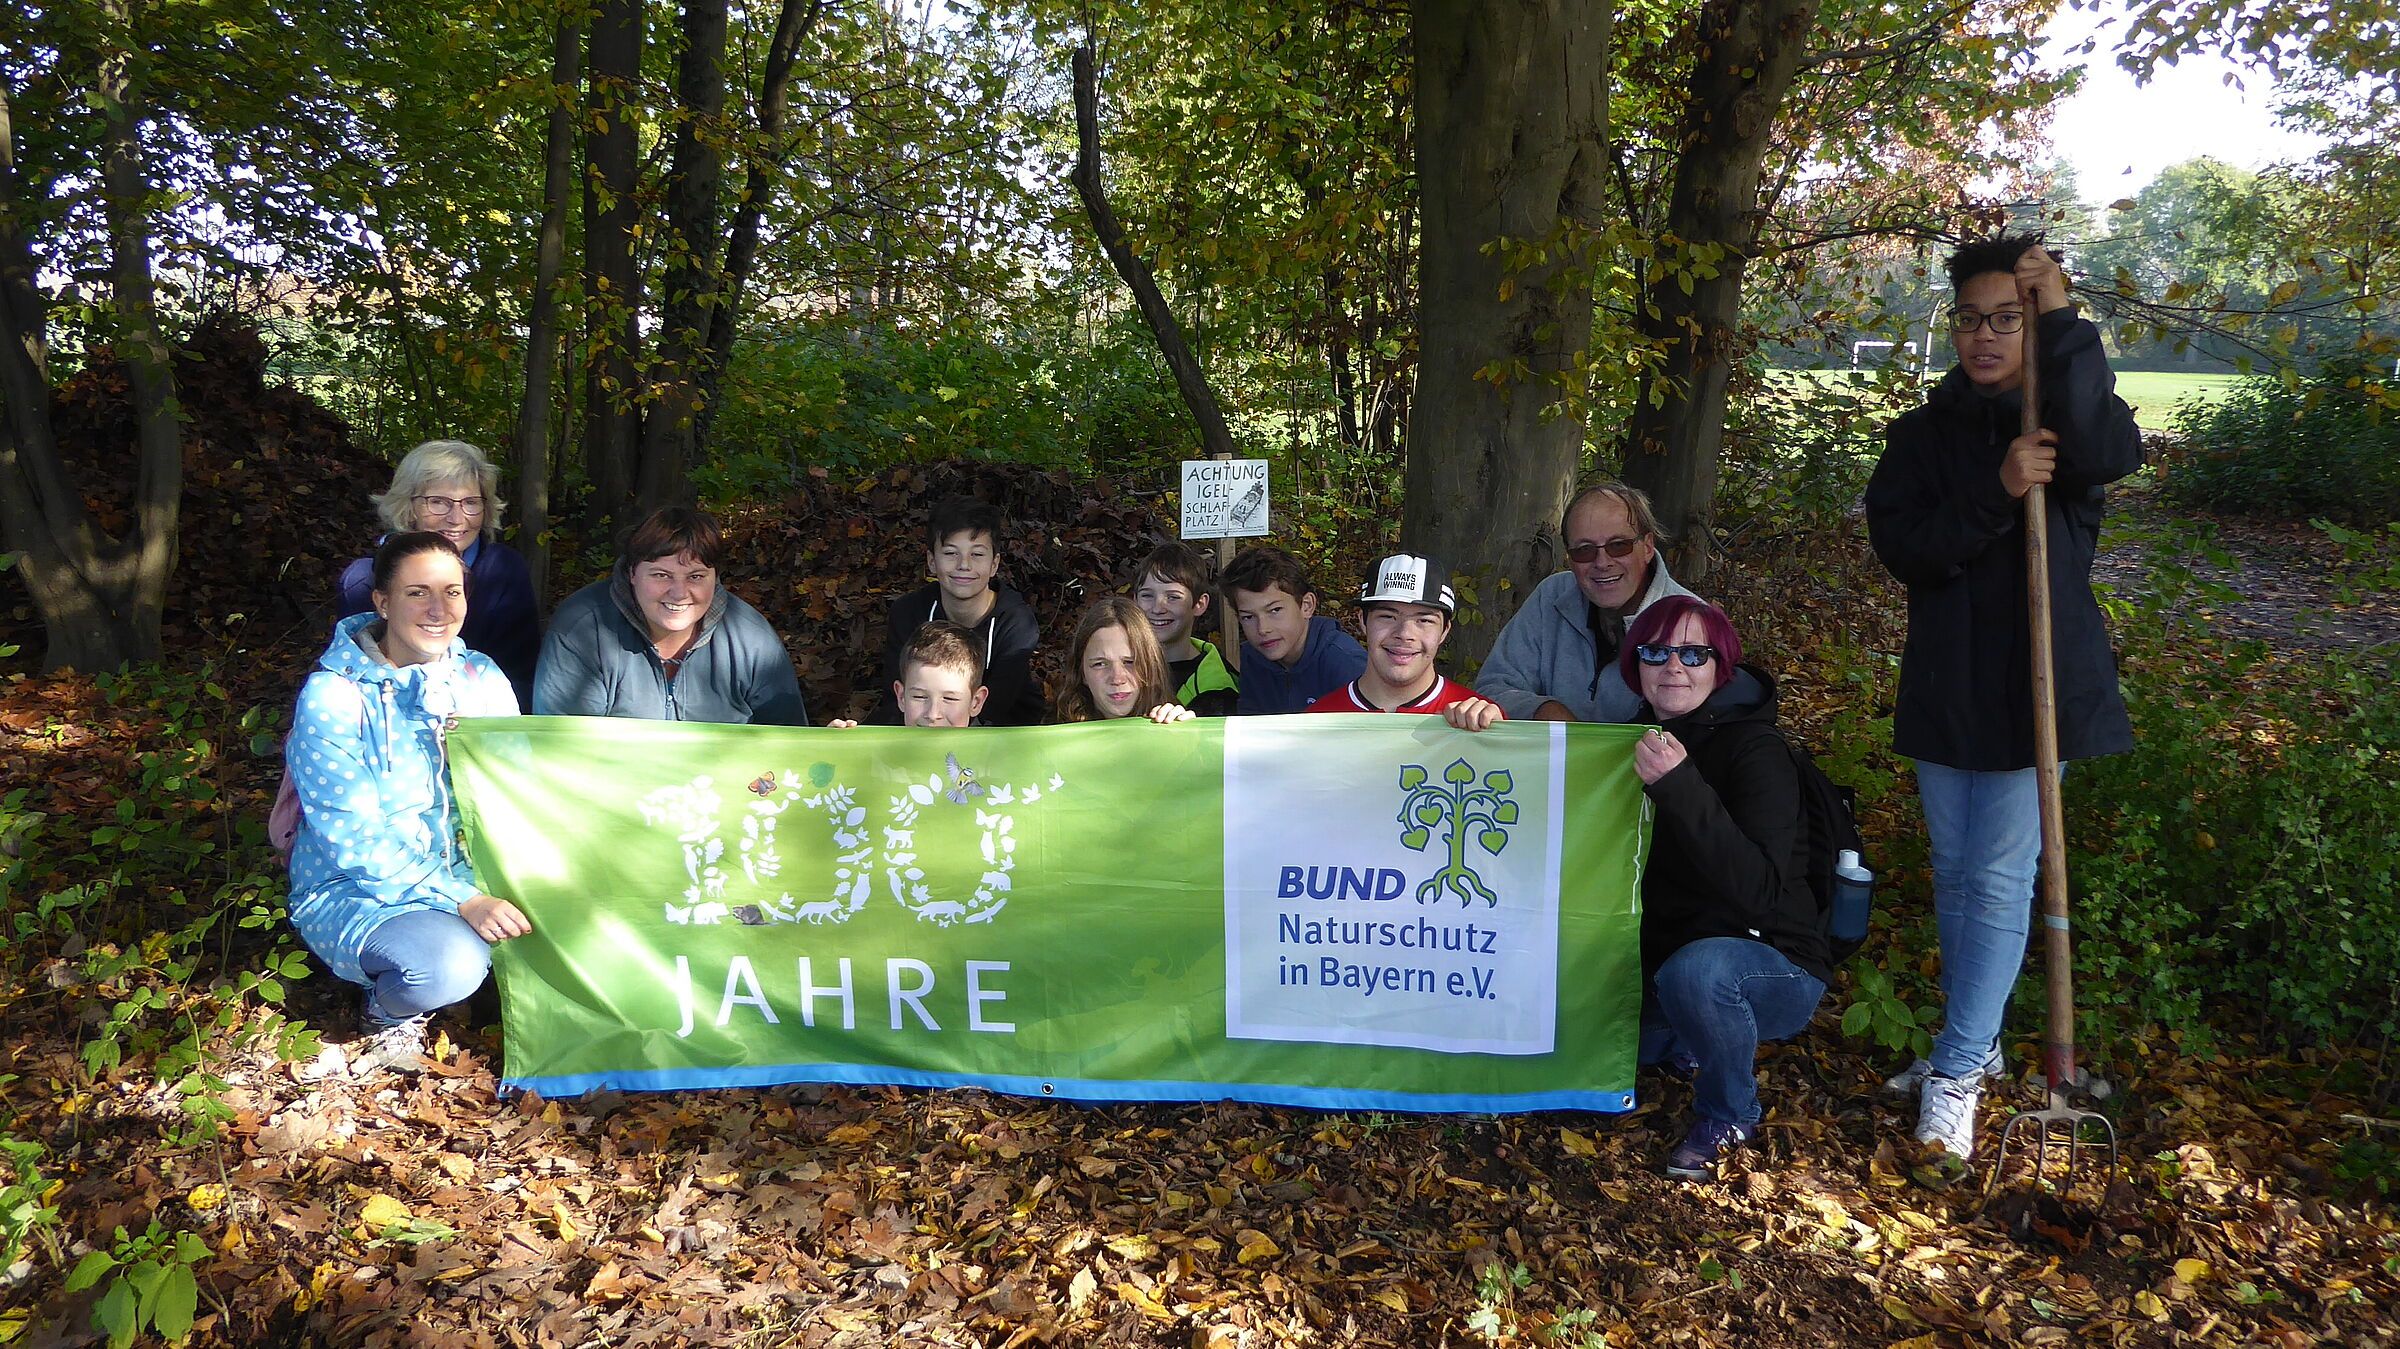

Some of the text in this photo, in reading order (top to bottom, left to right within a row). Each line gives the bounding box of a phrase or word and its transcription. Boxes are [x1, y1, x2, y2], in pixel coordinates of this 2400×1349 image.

[1186, 465, 1265, 482] ACHTUNG
[1185, 515, 1224, 528] PLATZ!
[1384, 572, 1416, 582] ALWAYS
[1384, 581, 1415, 590] WINNING
[1277, 866, 1406, 902] BUND
[1278, 913, 1497, 955] Naturschutz
[1279, 956, 1497, 1000] in Bayern e.V.
[674, 955, 1017, 1038] JAHRE
